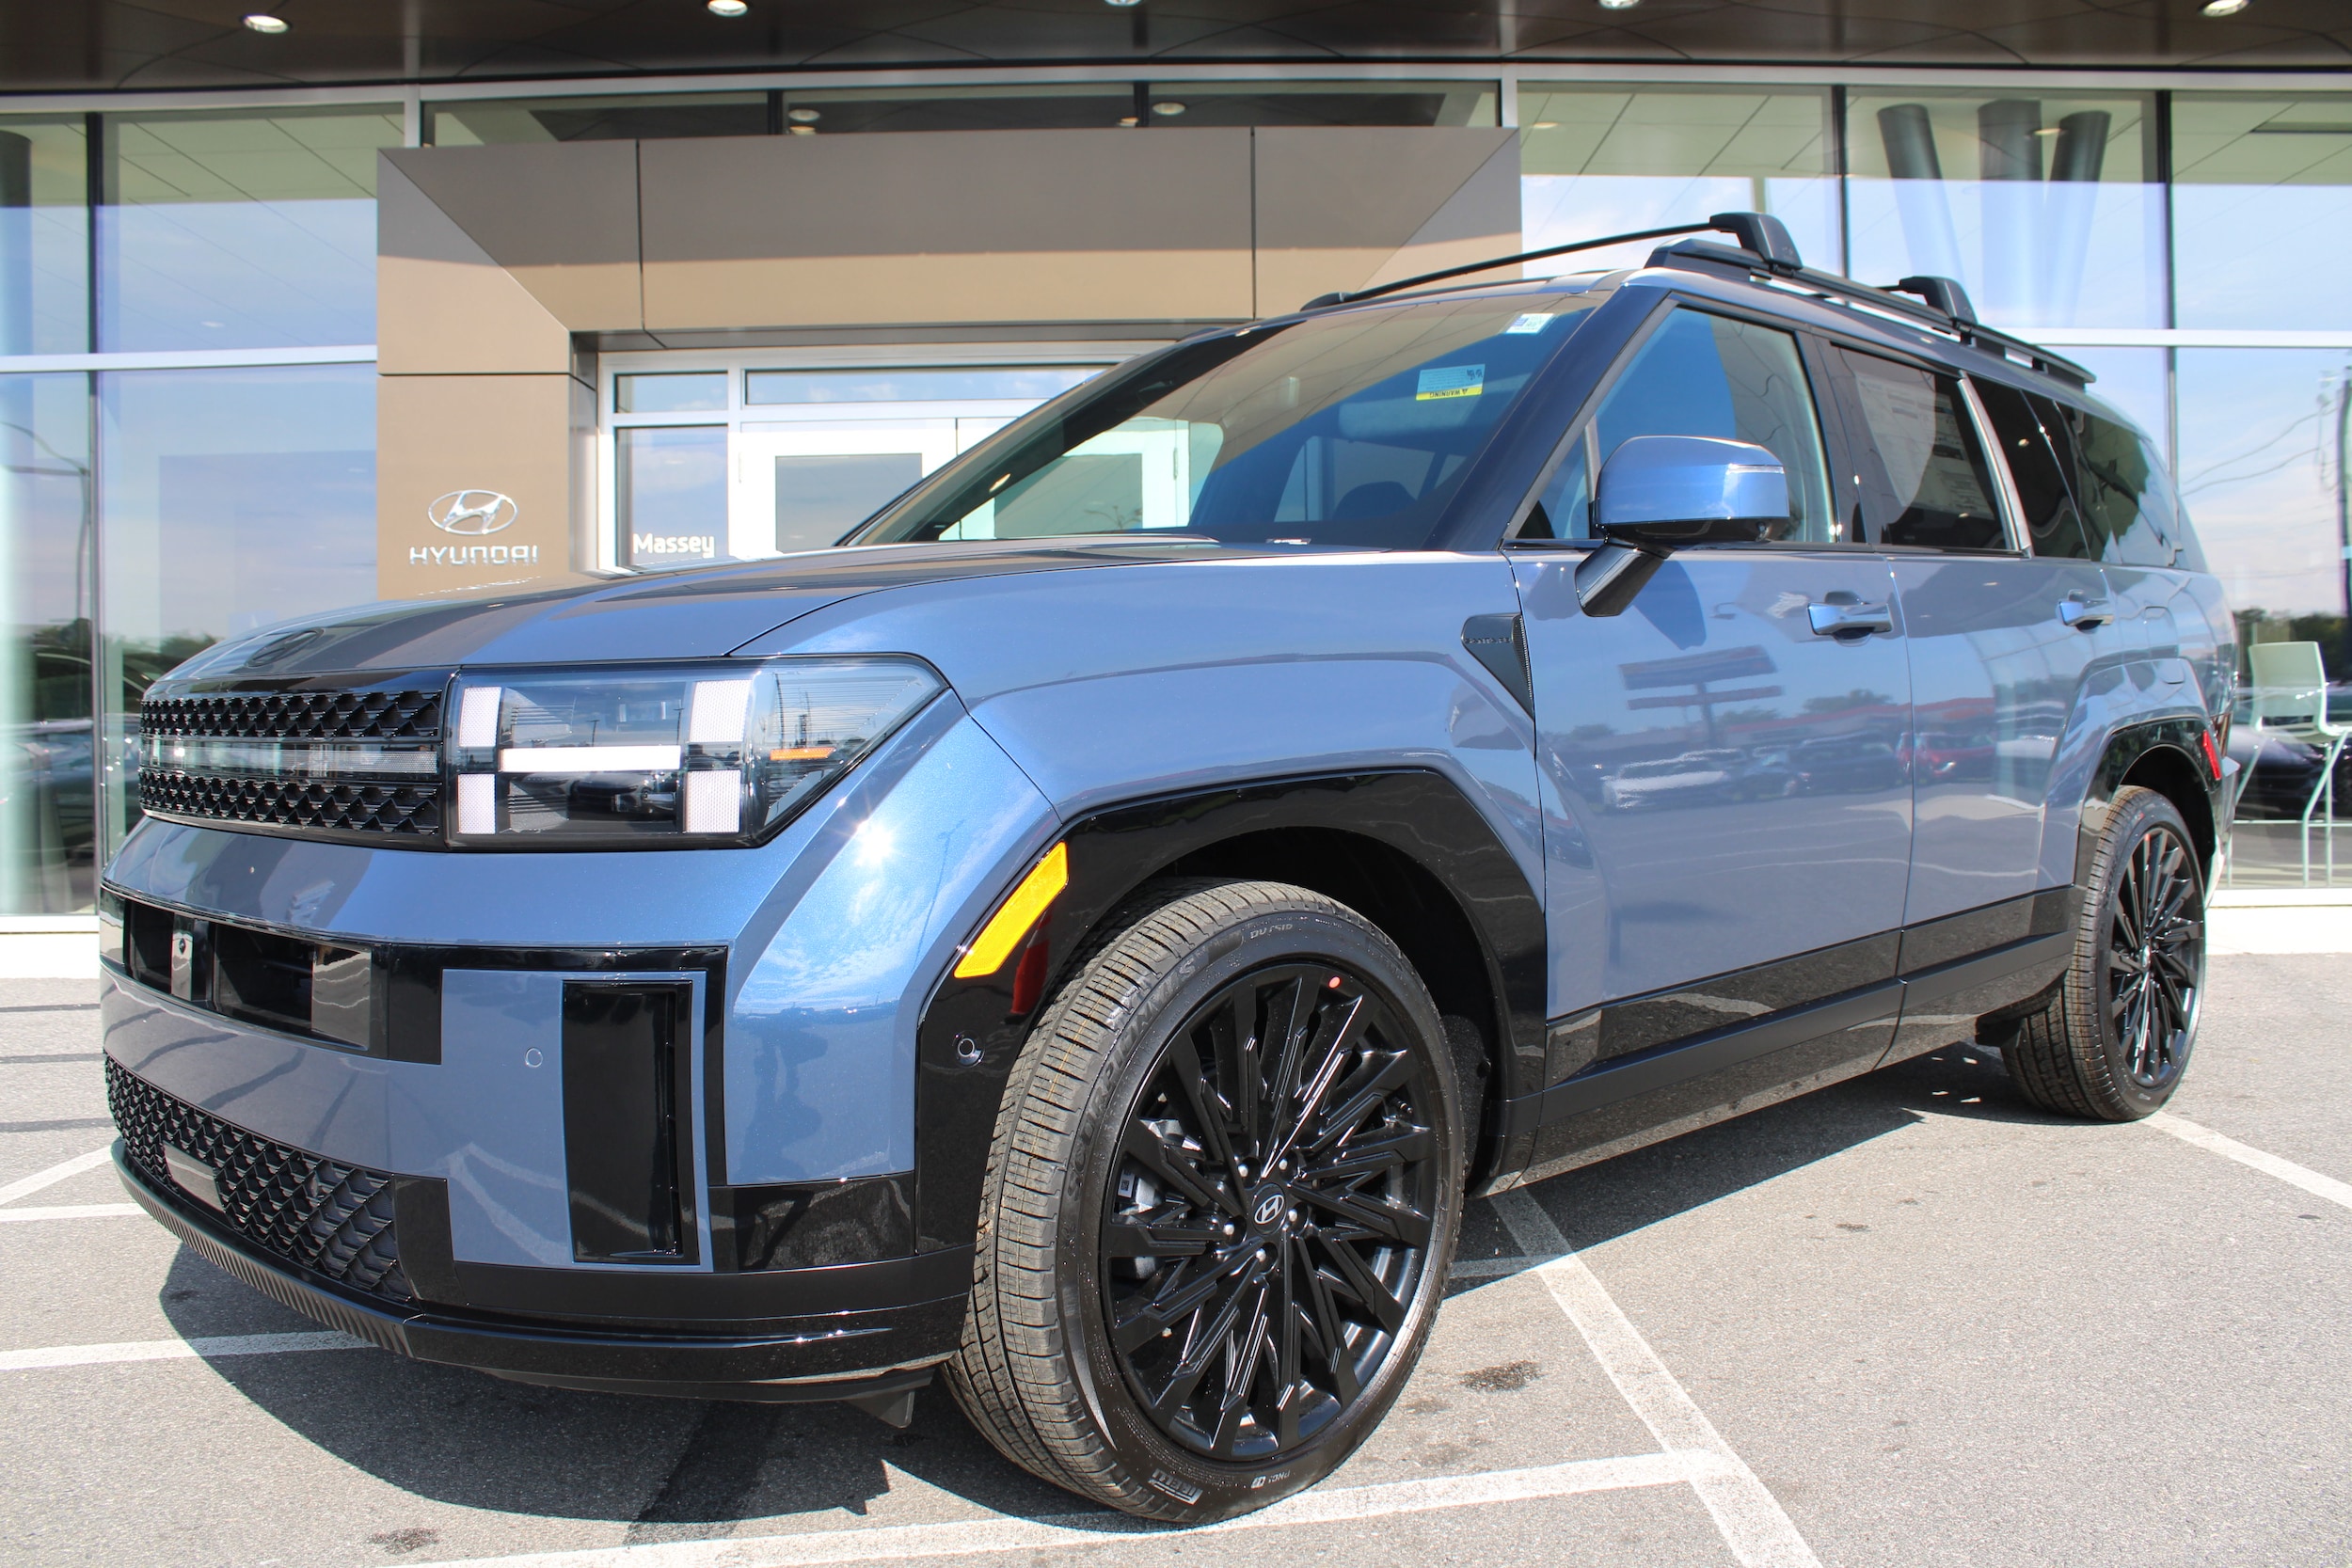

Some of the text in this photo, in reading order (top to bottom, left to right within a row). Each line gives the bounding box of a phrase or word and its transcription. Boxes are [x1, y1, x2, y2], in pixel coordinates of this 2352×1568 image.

[1429, 388, 1460, 399] WARNING
[409, 545, 538, 564] HYUNDAI
[633, 533, 714, 558] Massey
[1148, 1467, 1203, 1505] PIRELLI
